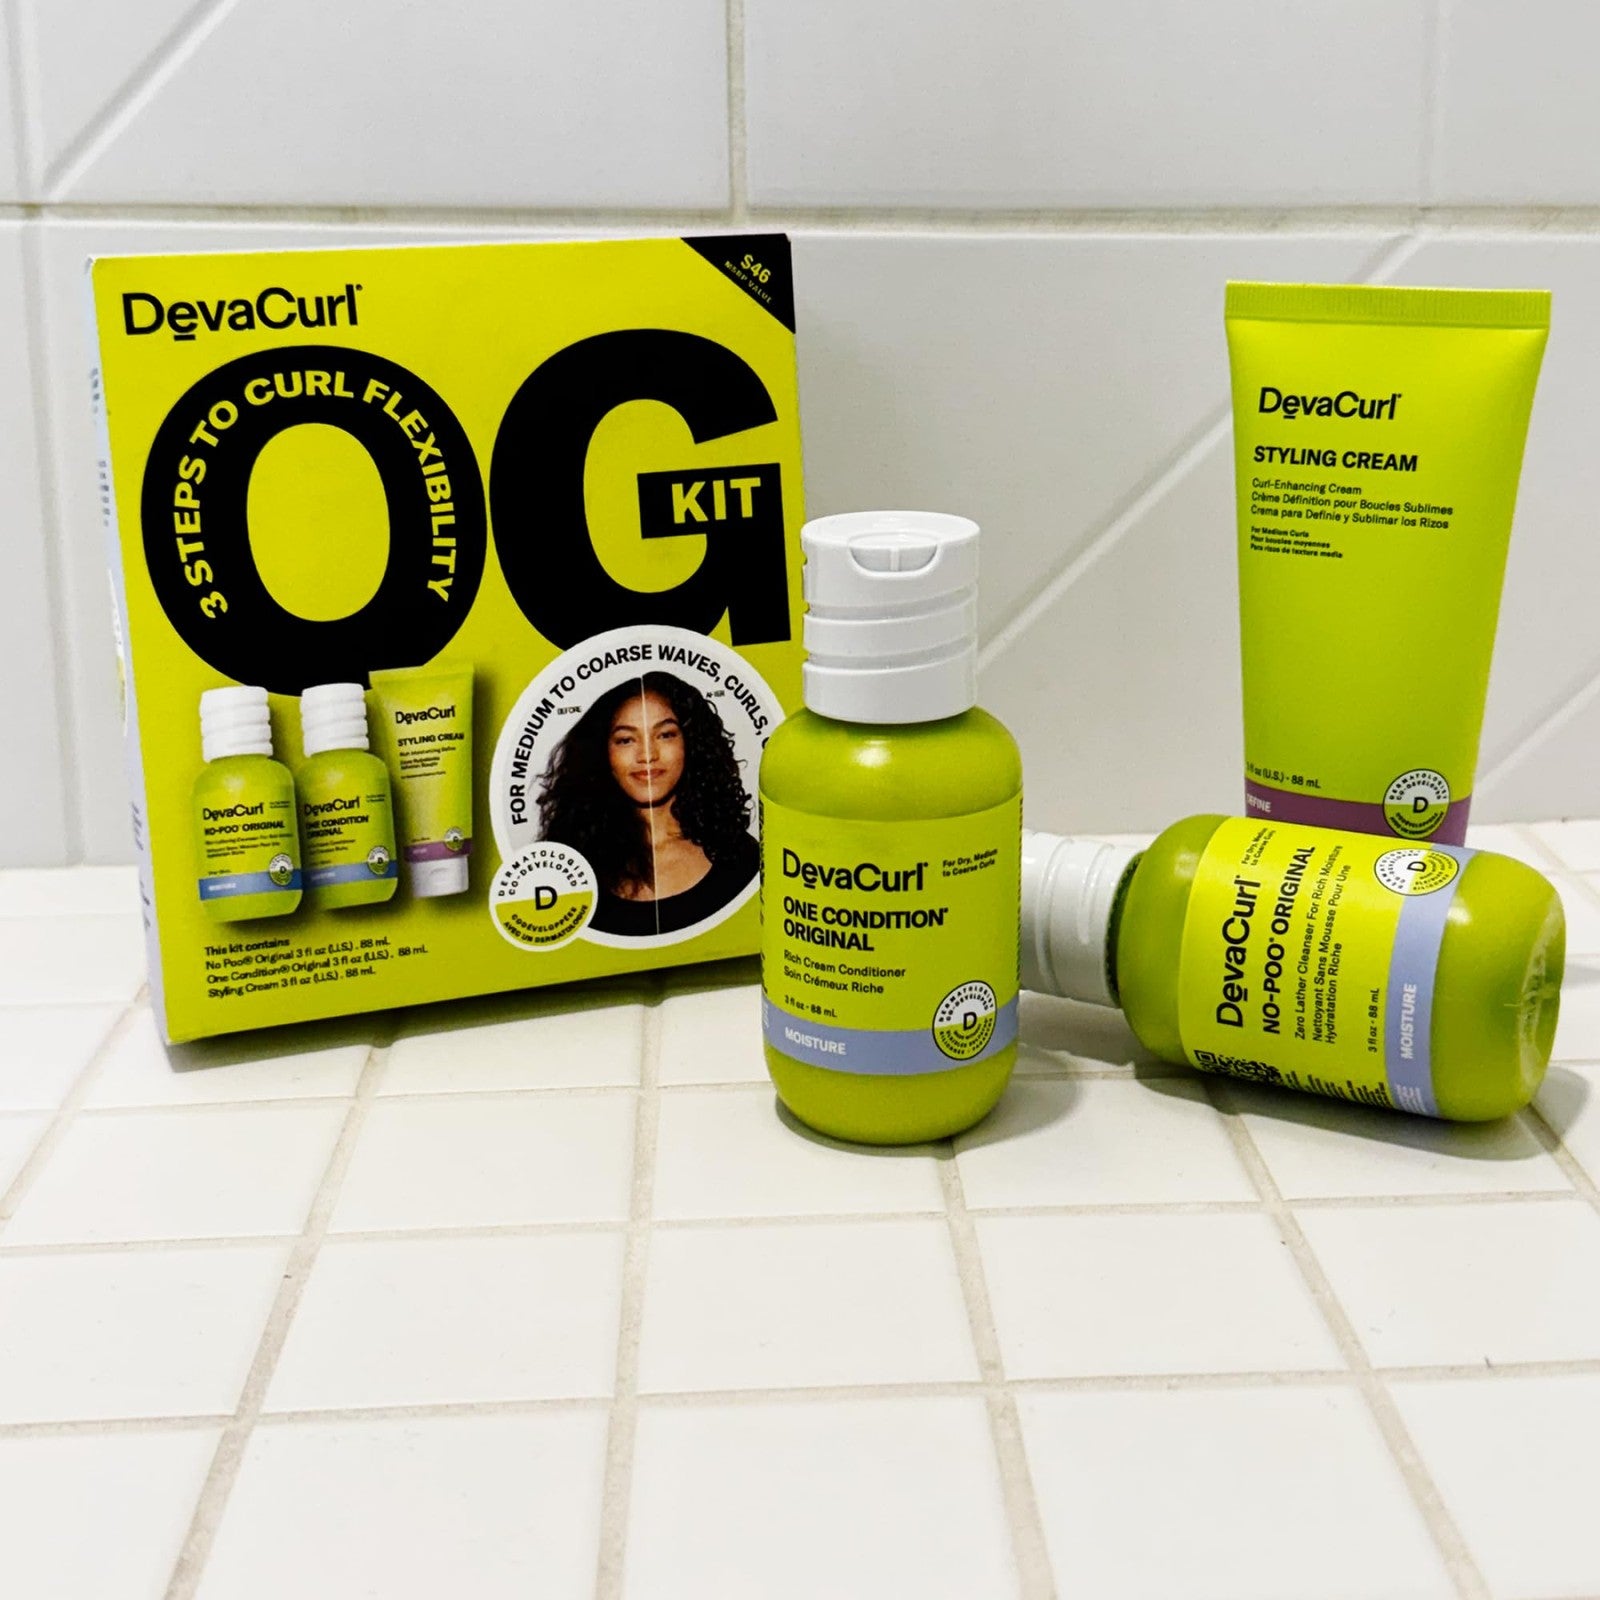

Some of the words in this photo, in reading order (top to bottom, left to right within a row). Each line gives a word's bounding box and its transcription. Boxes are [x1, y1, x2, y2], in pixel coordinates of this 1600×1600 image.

[748, 280, 772, 304] VALUE
[122, 284, 359, 341] DevaCurl
[244, 371, 354, 406] CURL
[1258, 387, 1399, 420] DevaCurl
[189, 400, 239, 447] TO
[1253, 445, 1337, 468] STYLING
[1342, 451, 1418, 472] CREAM
[363, 379, 456, 602] FLEXIBILITY
[671, 477, 761, 524] KIT
[1252, 478, 1326, 494] Curl-Enhancing
[1328, 483, 1363, 495] Cream
[1251, 505, 1279, 516] Crema
[1281, 509, 1303, 519] para
[1305, 508, 1341, 521] Definie
[1343, 513, 1350, 524] y
[1352, 512, 1398, 526] Sublimar
[1401, 515, 1417, 526] los
[1419, 518, 1449, 529] Rizos
[1282, 494, 1331, 507] Définition
[1333, 499, 1358, 510] pour
[1360, 500, 1400, 511] Boucles
[1403, 502, 1454, 515] Sublimes
[174, 455, 213, 587] STEPS
[1262, 527, 1289, 536] Medium
[1250, 543, 1263, 551] Para
[1265, 537, 1291, 545] boucles
[1293, 540, 1330, 548] moyennes
[200, 590, 228, 619] 3
[576, 644, 653, 680] COARSE
[658, 644, 721, 682] WAVES,
[550, 676, 576, 700] TO
[395, 705, 456, 725] DevaCurl
[724, 675, 768, 736] CURLS,
[398, 735, 436, 747] STYLING
[511, 698, 556, 779] MEDIUM
[1292, 775, 1304, 785] 88
[1306, 779, 1321, 788] mL
[203, 803, 263, 821] DevaCurl
[304, 796, 360, 816] DevaCurl
[510, 784, 528, 825] FOR
[1413, 797, 1429, 813] D
[242, 821, 285, 832] ORIGINAL
[322, 815, 369, 828] CONDITION
[498, 850, 588, 897] DERMATOLOGIST
[783, 847, 925, 892] DevaCurl
[952, 865, 978, 876] Coarse
[979, 859, 995, 869] Curls
[1241, 854, 1251, 864] For
[1319, 845, 1343, 877] Moisture
[1336, 864, 1351, 882] Une
[1406, 861, 1427, 873] D
[508, 860, 577, 895] CO-DEVELOPED
[1271, 846, 1315, 936] ORIGINAL
[1312, 877, 1327, 900] Rich
[535, 885, 558, 911] D
[1328, 881, 1343, 907] Pour
[503, 921, 522, 937] AVEC
[521, 933, 534, 942] UN
[534, 904, 588, 943] DERMATOLOGUE
[784, 895, 817, 922] ONE
[822, 907, 946, 929] CONDITION
[1306, 903, 1320, 920] For
[784, 918, 875, 952] ORIGINAL
[1318, 909, 1336, 953] Mousse
[205, 946, 227, 956] This
[229, 943, 243, 953] kit
[245, 938, 290, 951] contains
[206, 961, 221, 970] No
[255, 951, 294, 964] Original
[296, 948, 303, 957] 3
[305, 947, 312, 956] fl
[315, 947, 326, 955] oz
[360, 938, 373, 948] 88
[375, 936, 391, 946] mL
[1216, 876, 1262, 1028] DevaCurl
[1297, 923, 1315, 974] Cleanser
[1328, 942, 1342, 976] Riche
[207, 974, 228, 984] One
[292, 957, 331, 972] Original
[333, 956, 339, 966] 3
[341, 955, 348, 965] fl
[350, 955, 362, 964] oz
[398, 946, 411, 956] 88
[413, 944, 428, 954] mL
[784, 949, 802, 965] Rich
[803, 957, 836, 973] Cream
[838, 964, 906, 978] Conditioner
[1314, 954, 1327, 985] Sans
[208, 986, 244, 998] Styling
[245, 982, 279, 992] Cream
[281, 978, 288, 987] 3
[290, 976, 297, 985] fl
[300, 976, 311, 984] oz
[345, 968, 358, 977] 88
[360, 966, 375, 976] mL
[784, 965, 802, 981] Soin
[803, 973, 848, 991] Crémeux
[851, 982, 884, 994] Riche
[1263, 942, 1285, 1035] NO-POO
[796, 1001, 804, 1011] oz
[811, 1004, 822, 1015] 88
[824, 1009, 838, 1018] mL
[1295, 977, 1307, 1014] Lather
[1370, 988, 1380, 1003] mL
[963, 1011, 977, 1031] D
[1313, 987, 1324, 1042] Nettoyant
[1325, 981, 1338, 1044] Hydratation
[1368, 1005, 1378, 1018] 88
[1401, 983, 1417, 1059] MOISTURE
[784, 1026, 847, 1056] MOISTURE
[1295, 1015, 1305, 1040] Zero
[1370, 1026, 1377, 1037] oz
